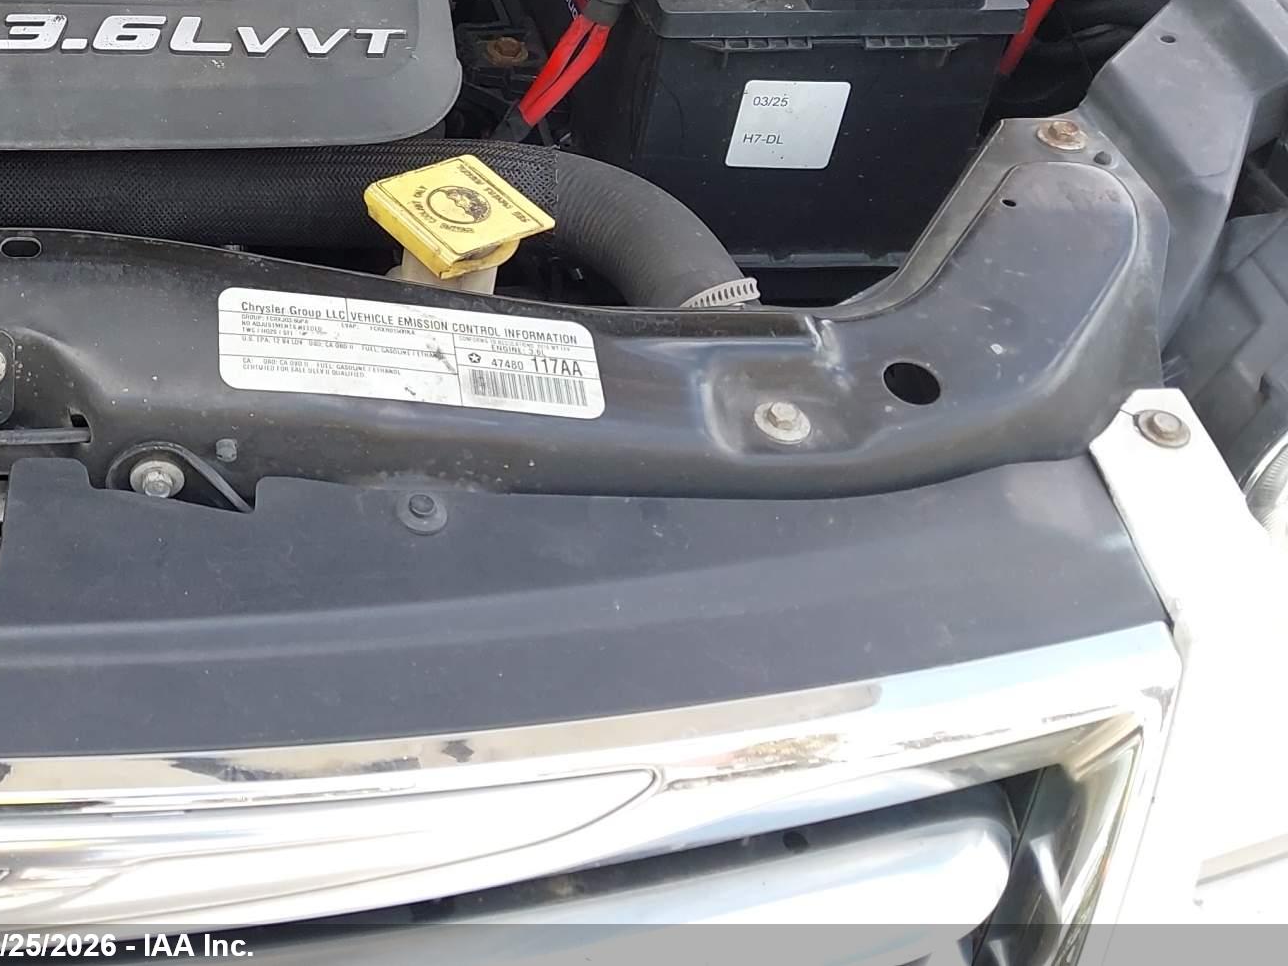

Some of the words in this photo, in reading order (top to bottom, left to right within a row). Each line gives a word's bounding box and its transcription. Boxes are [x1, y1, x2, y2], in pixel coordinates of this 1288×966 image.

[753, 96, 789, 107] 03/25
[743, 133, 784, 145] H7-DL
[241, 301, 285, 315] Chrysler
[289, 305, 322, 319] Group
[325, 309, 346, 320] LLC
[350, 311, 394, 325] VEHICLE
[398, 316, 449, 331] EMISSION
[452, 322, 501, 337] CONTROL
[504, 327, 577, 345] INFORMATION
[491, 358, 524, 371] 47480
[530, 355, 583, 377] 117AA
